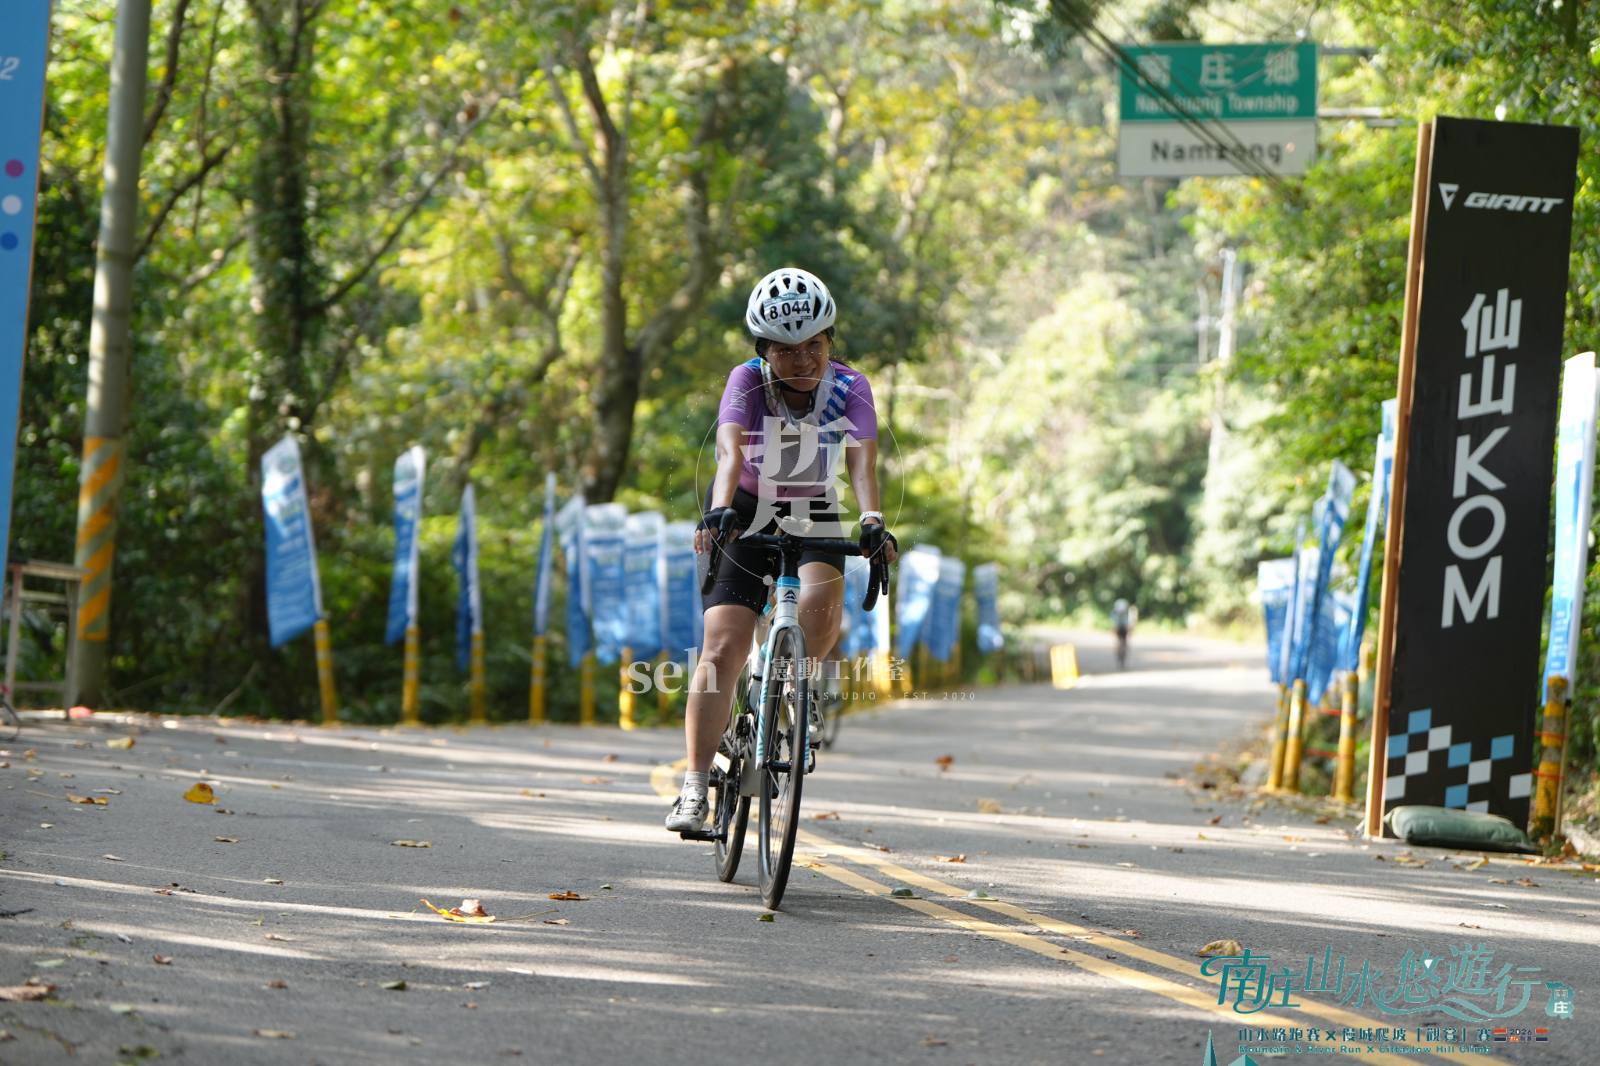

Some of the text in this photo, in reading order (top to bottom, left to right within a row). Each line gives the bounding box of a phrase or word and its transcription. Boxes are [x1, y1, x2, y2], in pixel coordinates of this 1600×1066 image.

[0, 56, 20, 81] 2
[1135, 93, 1299, 116] Nanhuang Township
[1463, 191, 1564, 214] GIANT
[769, 300, 811, 320] 8044
